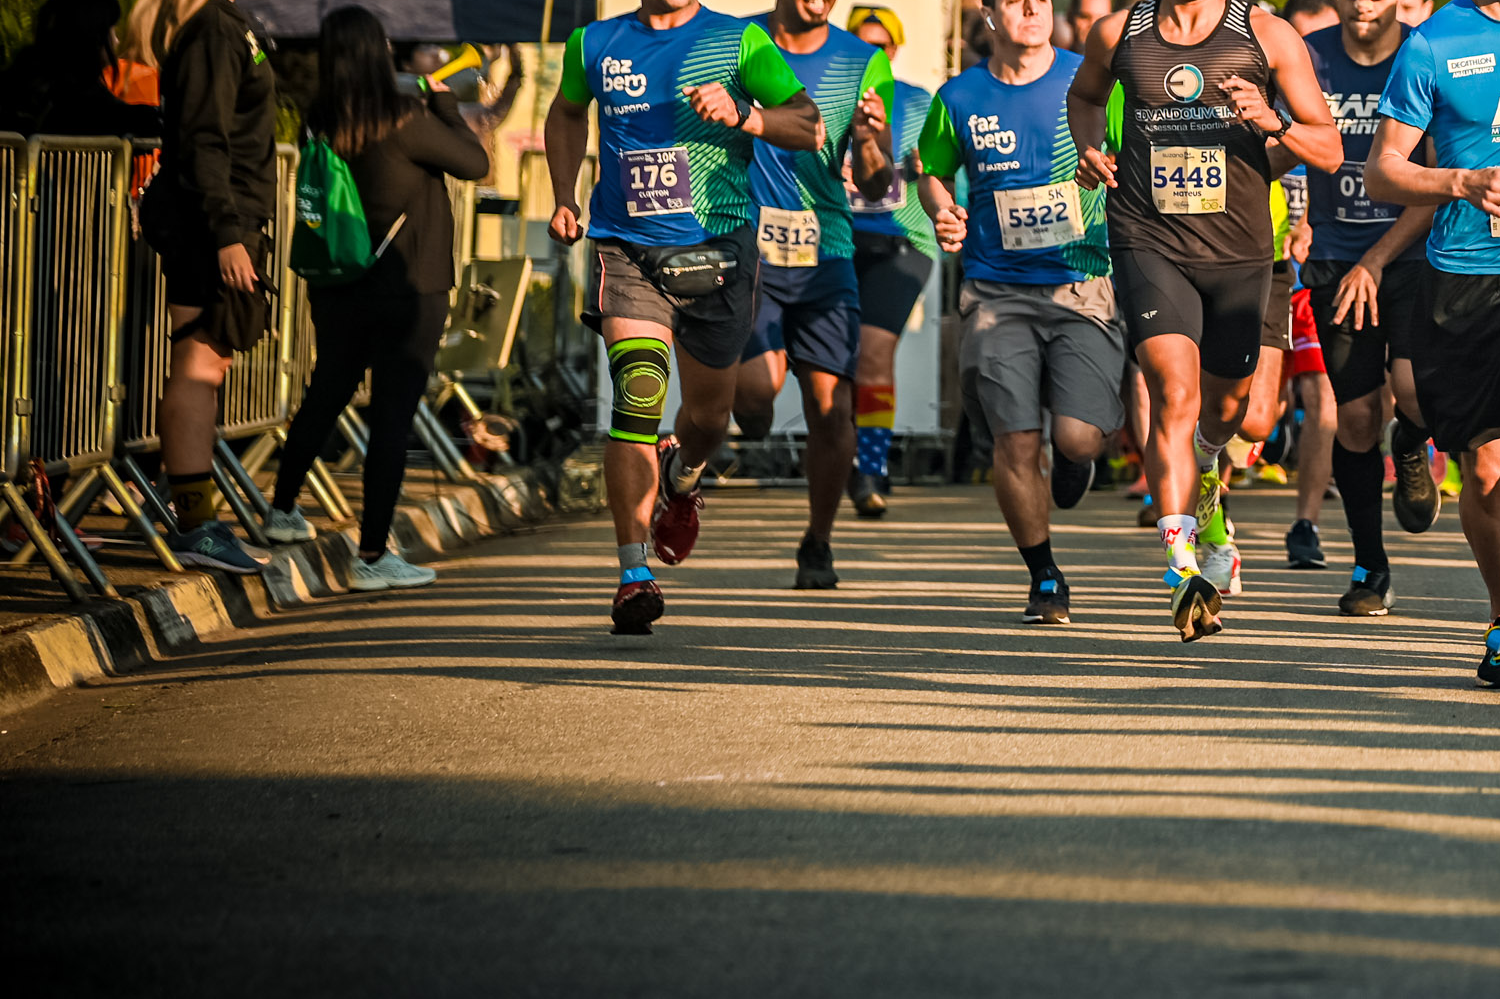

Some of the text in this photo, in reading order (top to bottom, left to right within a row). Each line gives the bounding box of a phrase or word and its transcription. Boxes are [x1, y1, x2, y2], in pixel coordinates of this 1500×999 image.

[601, 56, 633, 75] faz
[1451, 56, 1492, 69] DECATHLON
[602, 73, 647, 93] bem
[613, 102, 651, 116] suzano
[968, 114, 1000, 133] faz
[1190, 121, 1230, 132] Esportiva
[971, 130, 1016, 150] bem
[656, 152, 677, 163] 10K
[1200, 150, 1218, 163] 5K
[630, 163, 678, 189] 176
[1153, 165, 1222, 188] 5448
[1048, 188, 1064, 200] 5K
[1009, 202, 1069, 228] 5322
[761, 223, 816, 246] 5312
